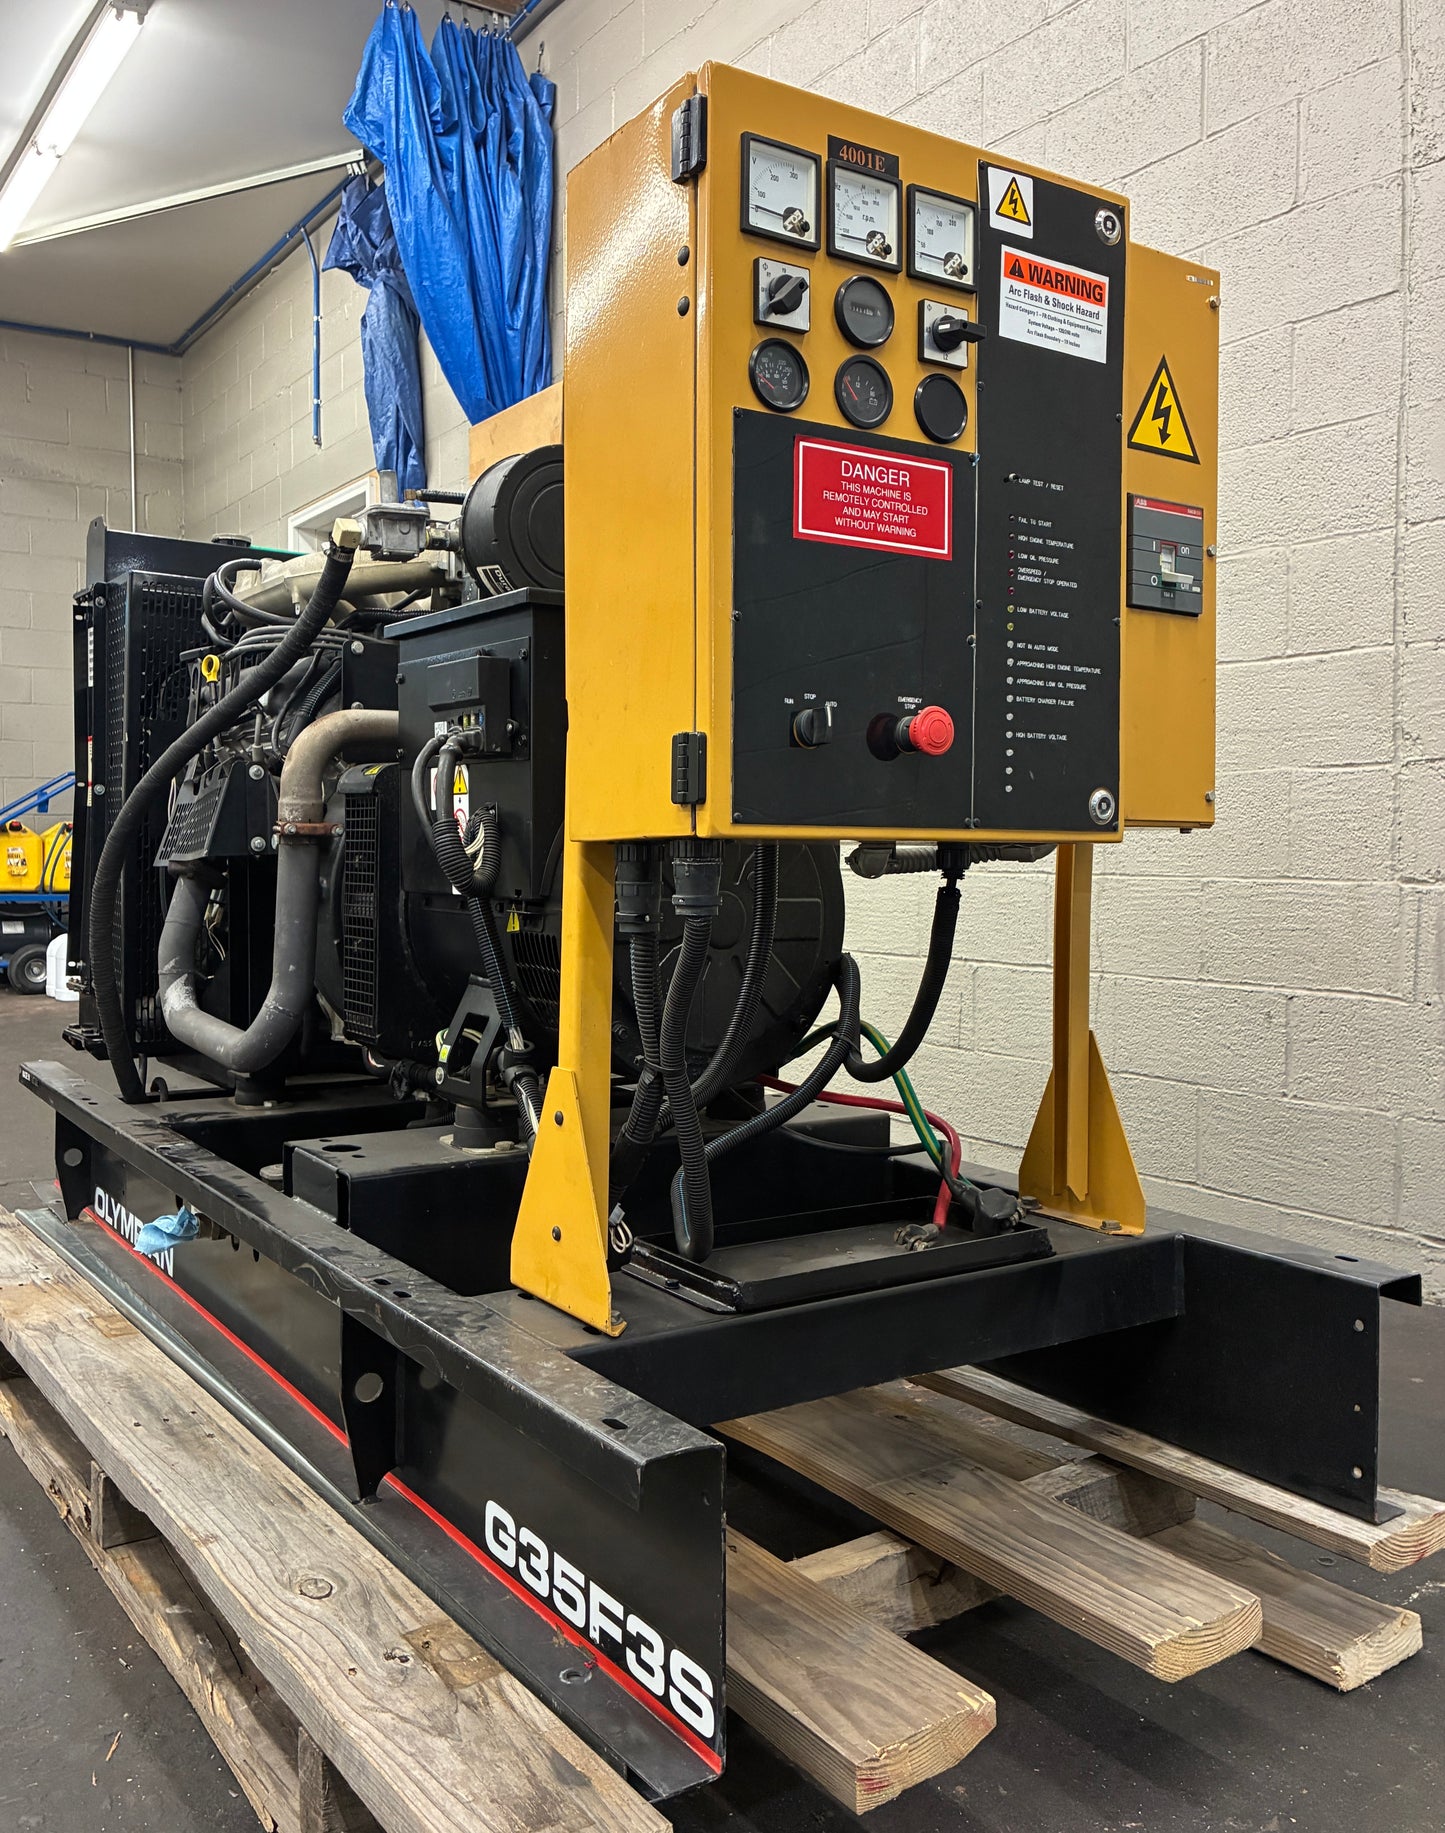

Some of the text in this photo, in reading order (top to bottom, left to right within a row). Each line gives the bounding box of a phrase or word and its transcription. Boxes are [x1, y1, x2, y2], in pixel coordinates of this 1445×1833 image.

[752, 157, 757, 165] V
[839, 144, 886, 173] 4001E
[770, 173, 780, 183] 200
[789, 171, 798, 180] 300
[757, 190, 766, 199] 100
[916, 208, 921, 216] A
[926, 228, 934, 236] 100
[1028, 263, 1103, 303] WARNING
[1008, 284, 1100, 320] Arc Flash & Shock Hazard
[1005, 302, 1019, 311] Hazard
[1019, 305, 1036, 317] Category
[1048, 313, 1063, 325] Clothing
[1066, 319, 1086, 331] Equipment
[1086, 324, 1102, 335] Required
[1028, 318, 1042, 328] System
[1042, 320, 1055, 332] Voltage
[1033, 330, 1044, 338] Flash
[1044, 332, 1061, 344] Boundary
[841, 460, 910, 487] DANGER
[841, 480, 912, 501] THIS MACHINE IS
[1050, 484, 1064, 492] RESET
[823, 490, 928, 516] REMOTELY CONTROLLED
[1136, 498, 1148, 506] ABB
[842, 506, 909, 525] AND MAY START
[1018, 516, 1052, 528] FAIL TO START
[834, 516, 917, 538] WITHOUT WARNING
[1018, 534, 1074, 550] HIGH ENGINE TEMPERATURE
[1180, 546, 1190, 556] on
[1018, 552, 1028, 560] LOW
[1038, 555, 1060, 564] PRESSURE
[1017, 574, 1042, 584] EMERGENCY
[1056, 580, 1078, 588] OPERATED
[1016, 606, 1070, 619] LOW BATTERY VOLTAGE
[1016, 660, 1044, 669] APPROACHING
[1057, 664, 1072, 672] ENGINE
[1073, 666, 1102, 675] TEMPERATURE
[1016, 678, 1044, 686] APPROACHING
[1066, 682, 1087, 690] PRESSURE
[898, 696, 922, 704] EMERGENCY
[1016, 696, 1036, 704] BATTERY
[1026, 732, 1047, 740] BATTERY
[485, 1500, 715, 1739] G35F3S
